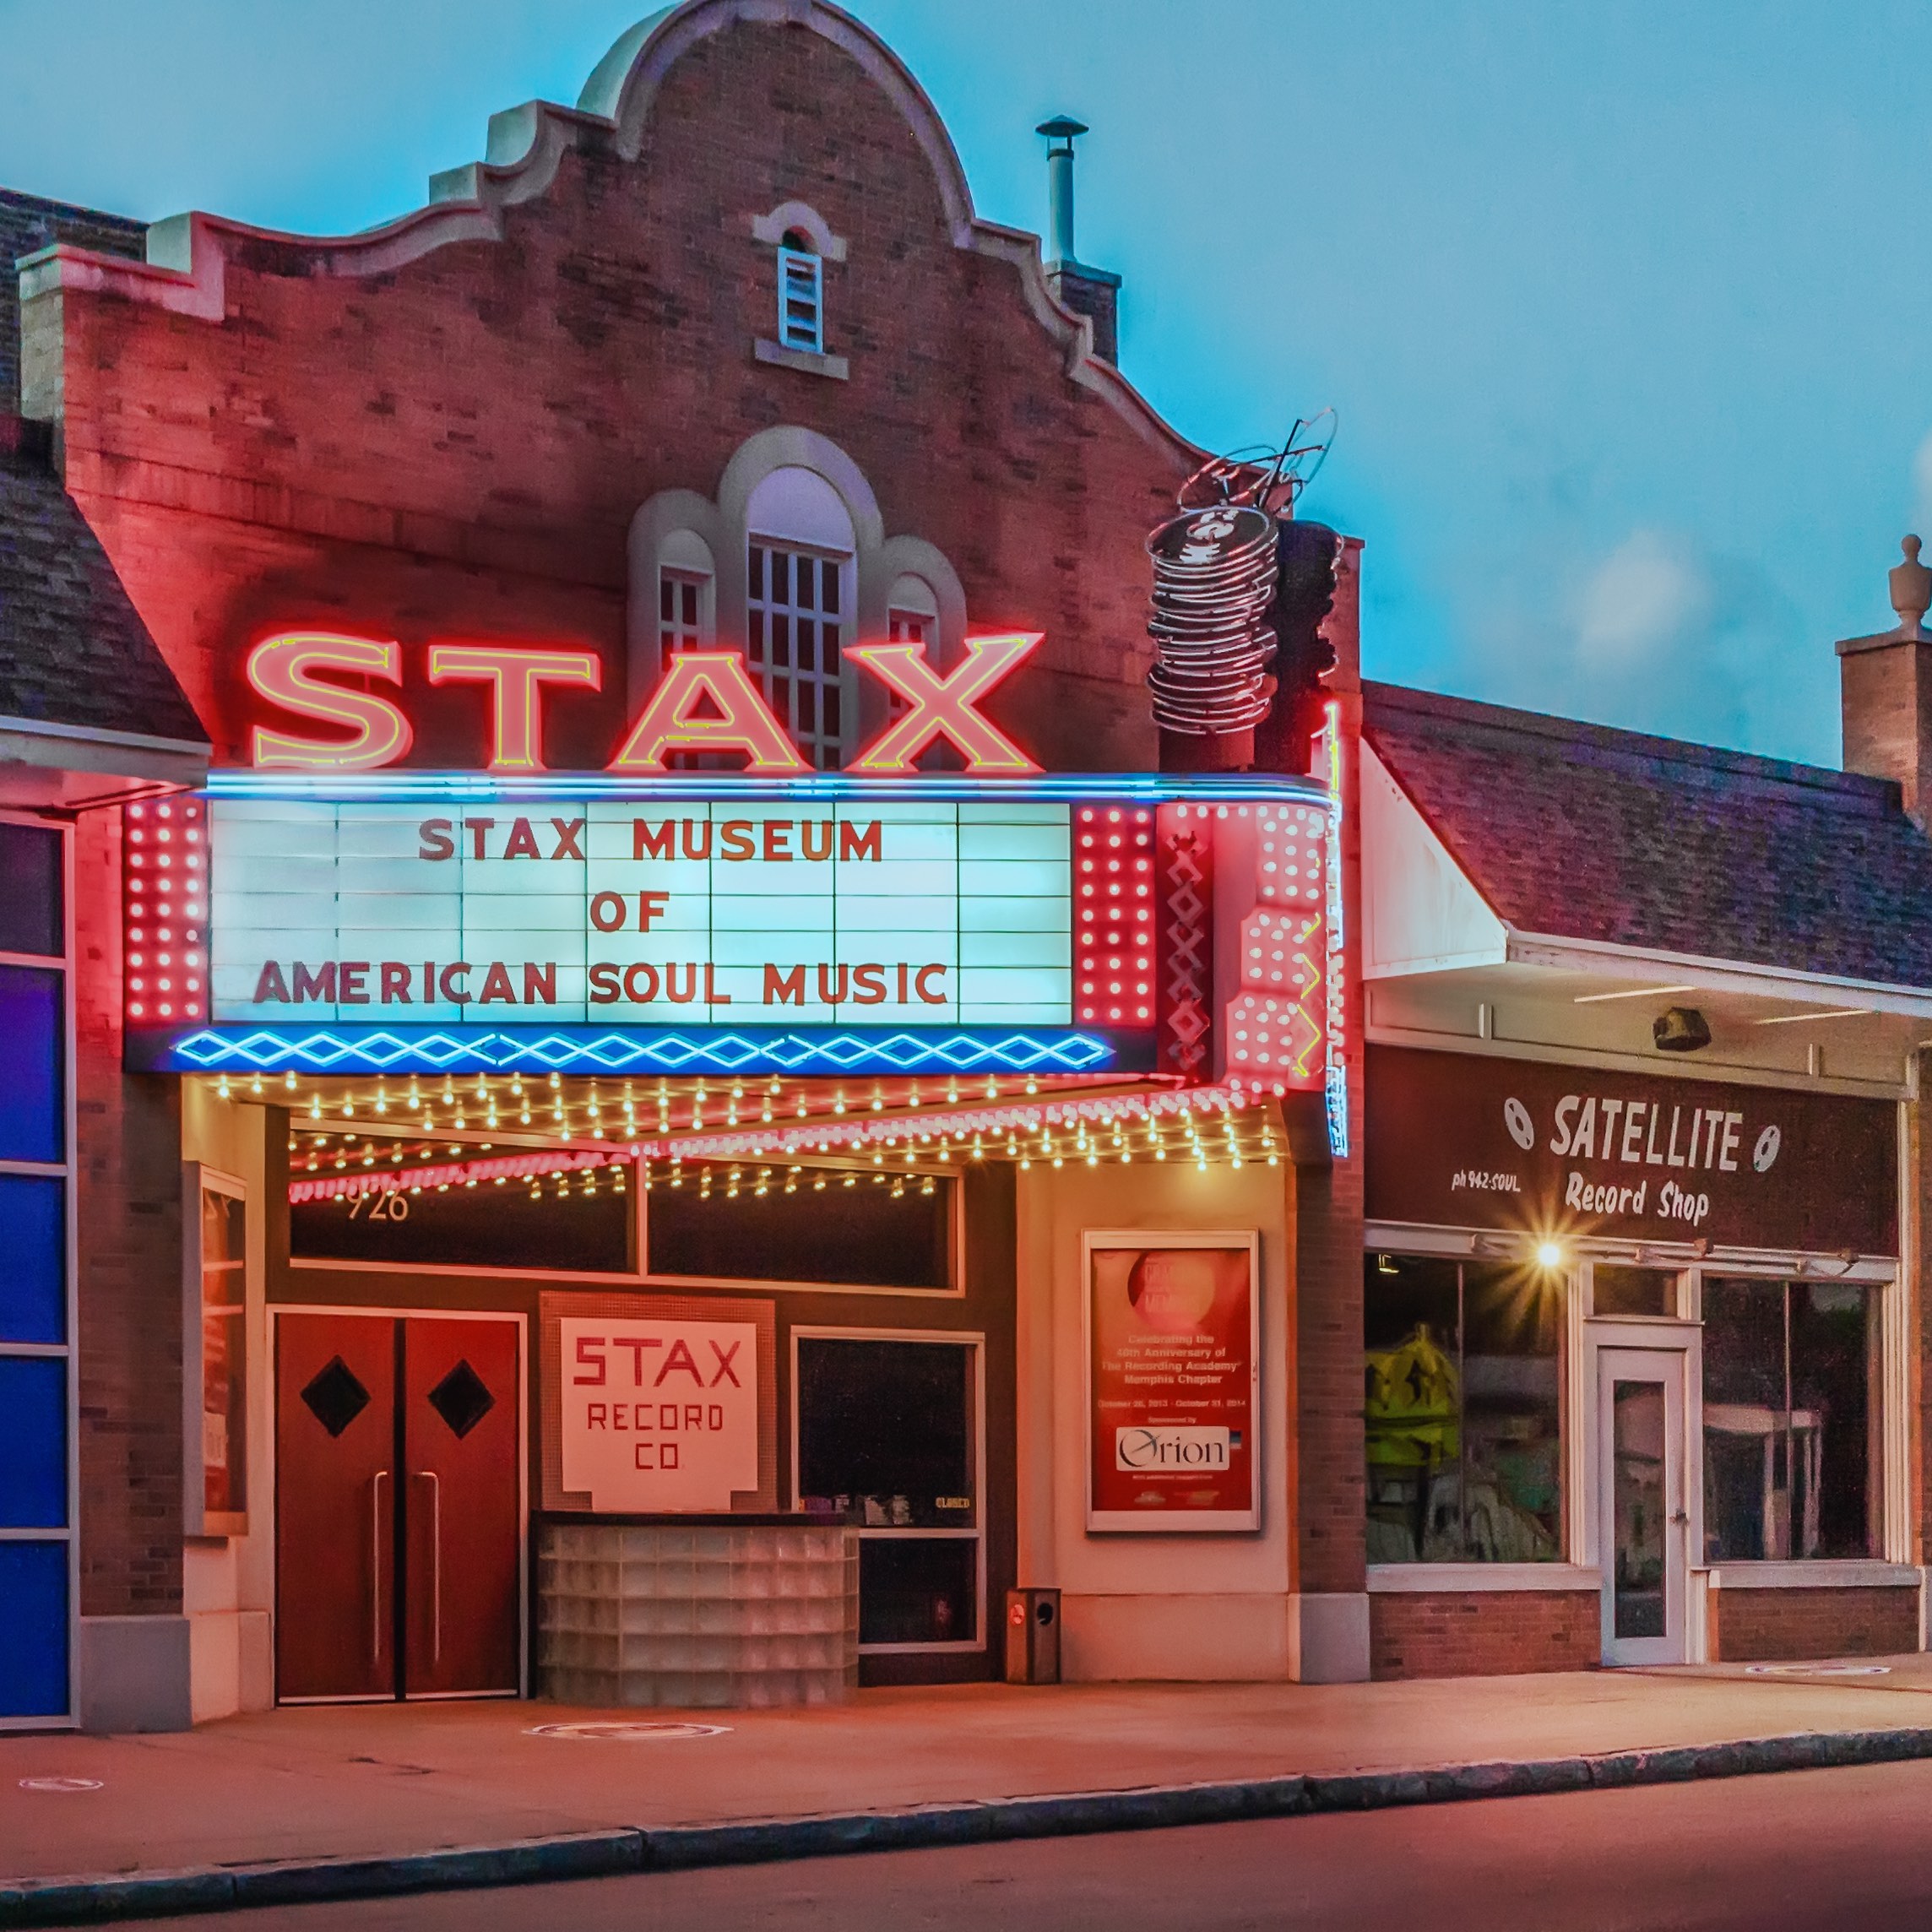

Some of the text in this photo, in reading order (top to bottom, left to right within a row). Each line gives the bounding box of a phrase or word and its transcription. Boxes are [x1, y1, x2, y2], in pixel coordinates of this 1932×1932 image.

[247, 631, 1047, 772] STAX
[419, 817, 882, 862] STAX MUSEUM
[589, 890, 670, 933] OF
[252, 960, 948, 1006] AMERICAN SOUL MUSIC
[1549, 1094, 1744, 1172] SATELLITE
[346, 1177, 409, 1221] 926
[1565, 1171, 1710, 1226] Record Shop
[1128, 1335, 1214, 1346] Celebrating the
[1144, 1348, 1211, 1359] Anniversary
[1215, 1347, 1226, 1357] of
[573, 1337, 741, 1388] STAX
[1102, 1361, 1121, 1370] The
[1125, 1361, 1182, 1372] Recording
[1125, 1375, 1222, 1386] Memphis Chapter
[588, 1403, 724, 1431] RECORD
[635, 1442, 678, 1470] CO
[1119, 1429, 1224, 1468] Orion
